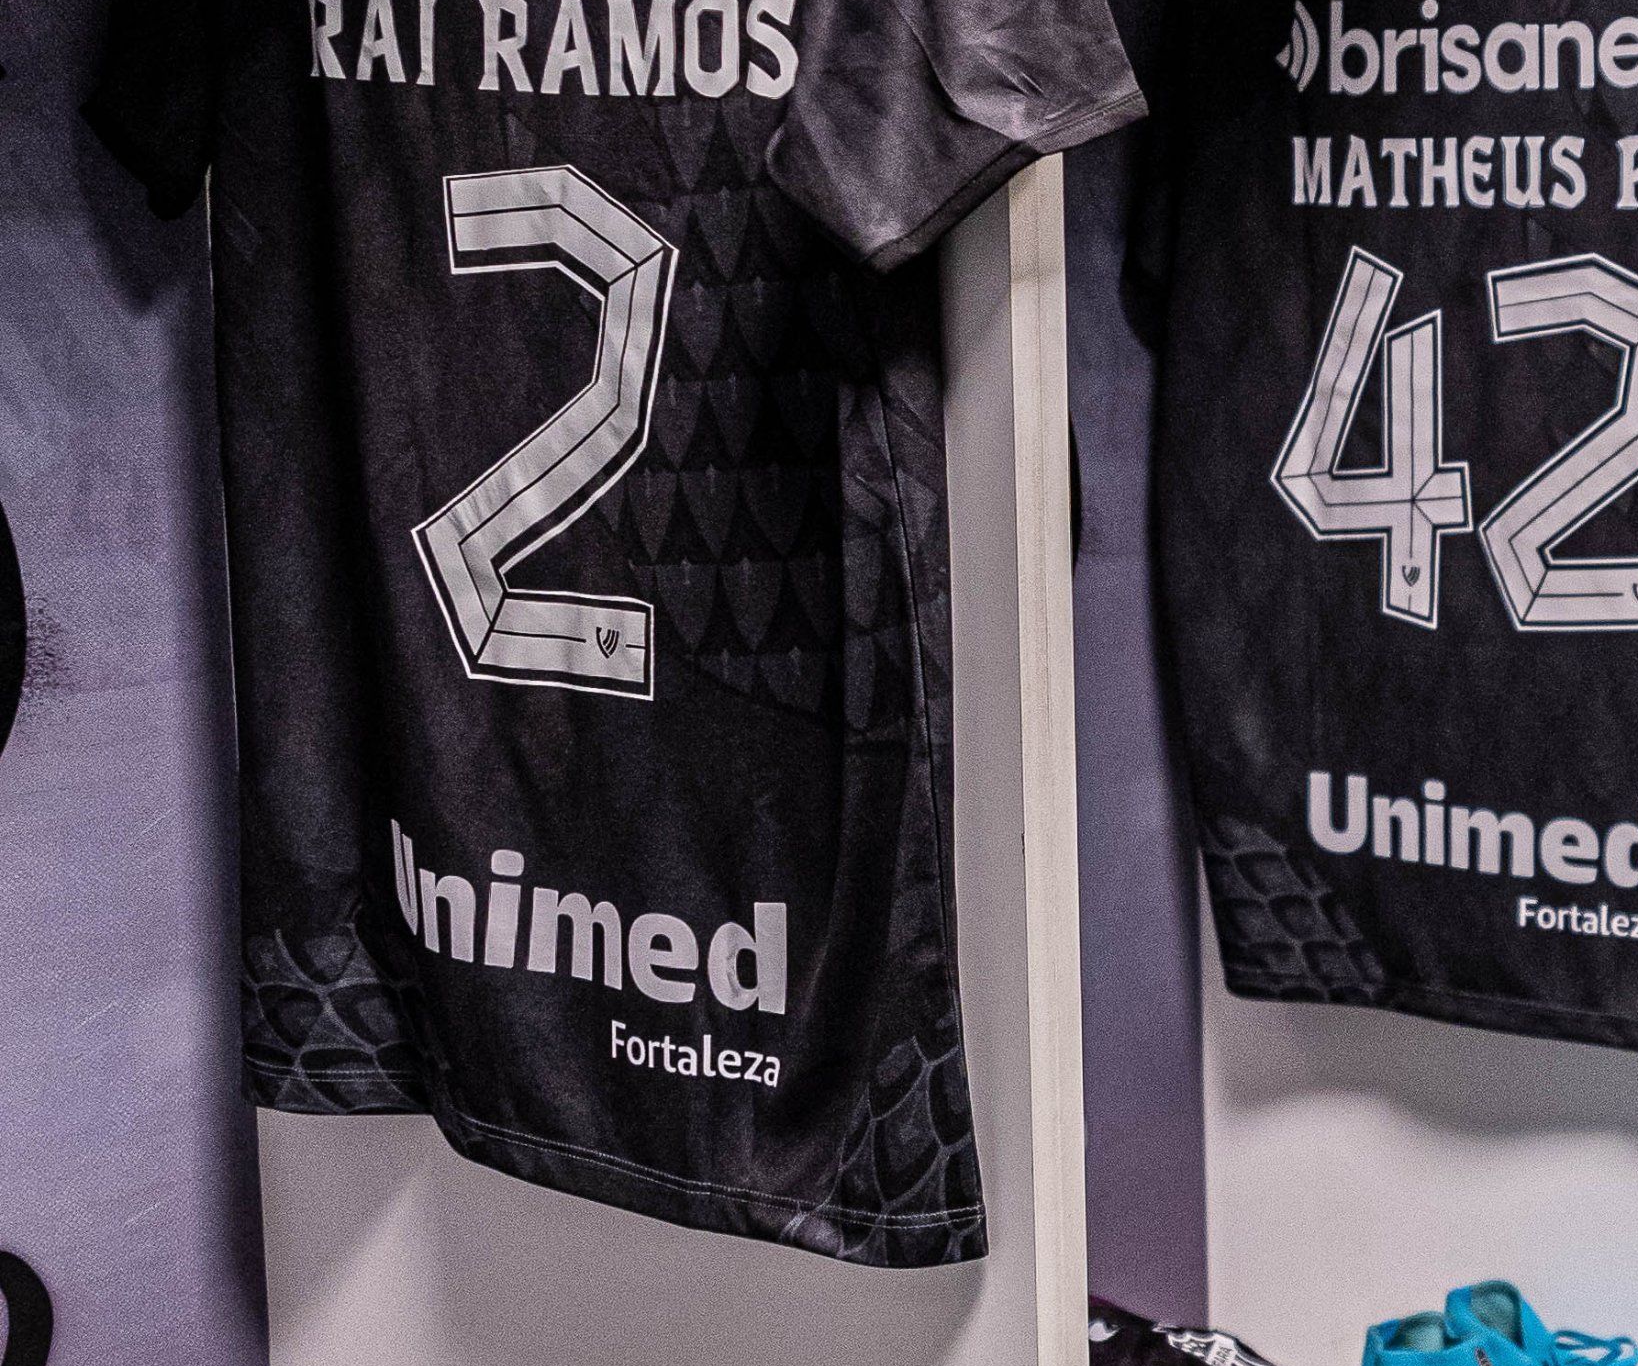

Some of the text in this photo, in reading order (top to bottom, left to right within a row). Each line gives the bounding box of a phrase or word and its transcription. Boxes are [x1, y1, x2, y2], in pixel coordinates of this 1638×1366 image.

[1293, 136, 1588, 209] MATHEUS
[411, 164, 680, 701] 2
[391, 818, 788, 1015] Unimed
[611, 1020, 782, 1088] Fortaleza
